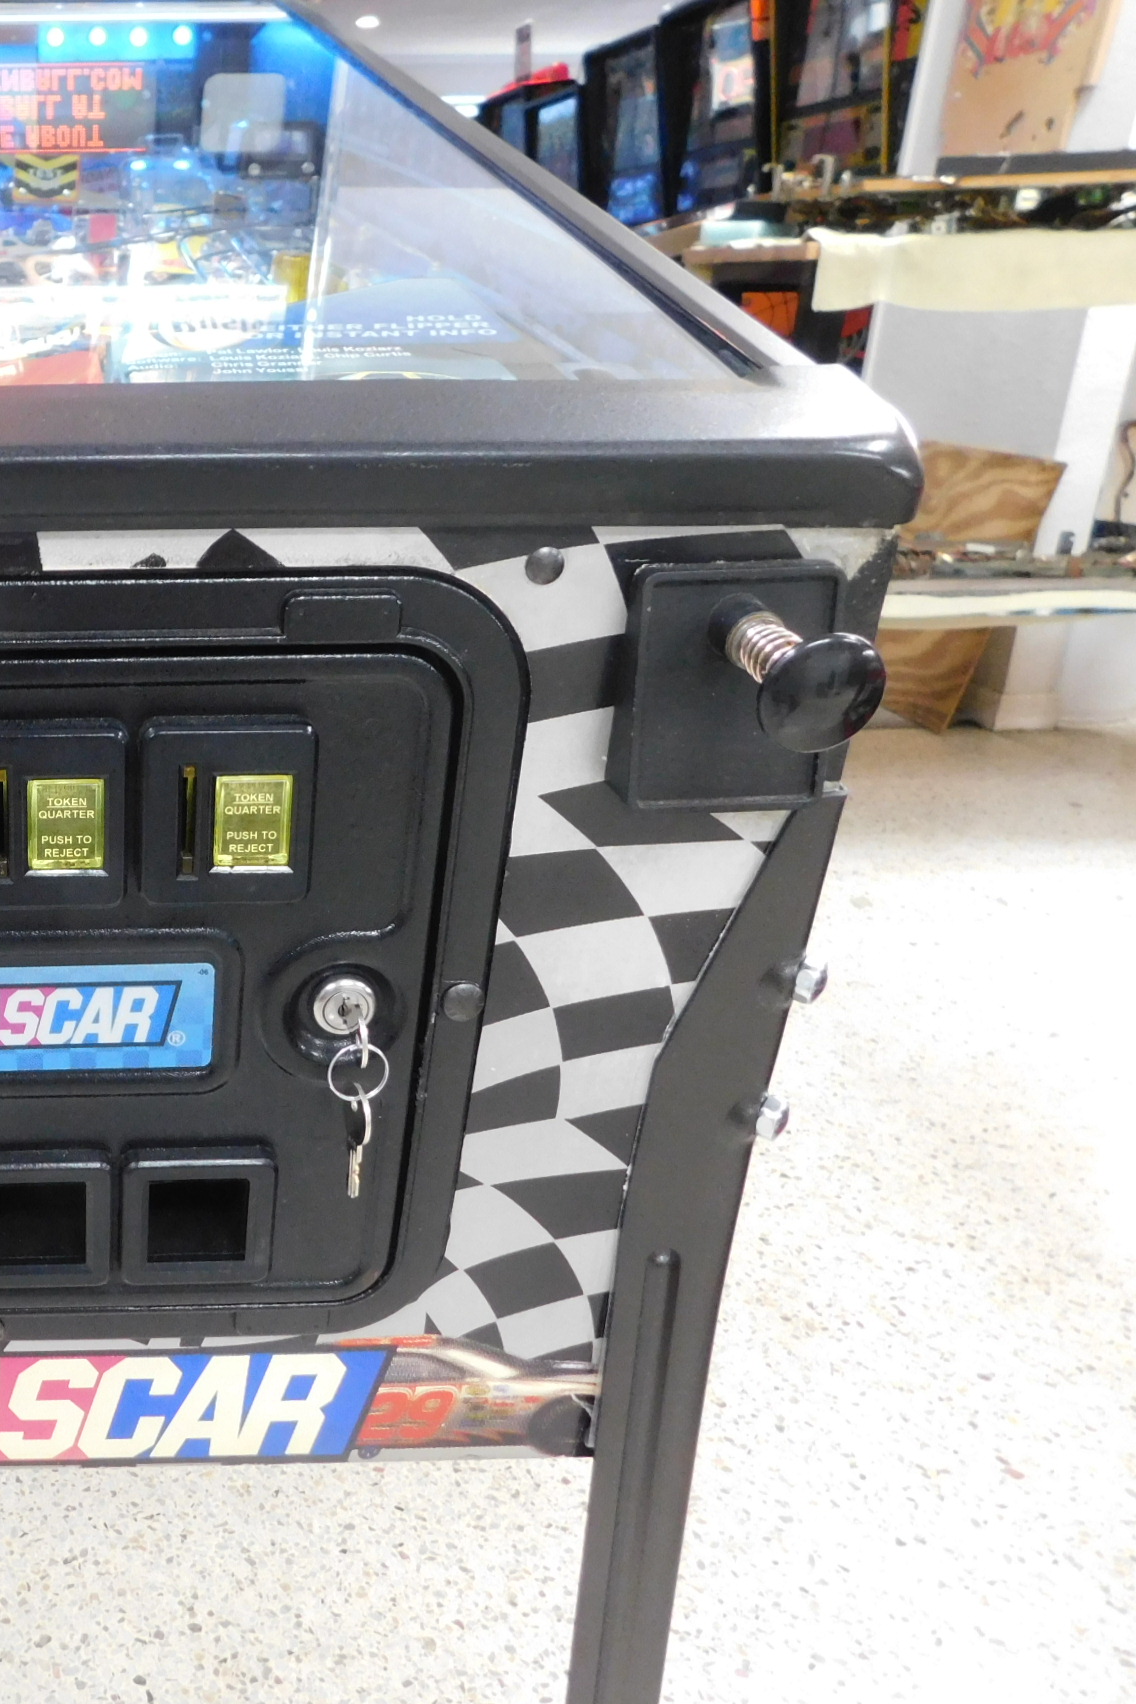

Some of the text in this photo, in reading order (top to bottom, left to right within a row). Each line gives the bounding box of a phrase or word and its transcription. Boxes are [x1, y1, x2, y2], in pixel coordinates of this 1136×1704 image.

[406, 314, 482, 322] HOLD
[374, 321, 490, 330] FLIPPER
[429, 328, 498, 337] INFO
[46, 797, 87, 807] TOKEN
[232, 792, 274, 803] TOKEN
[38, 809, 95, 819] QUARTER
[224, 804, 281, 815] QUARTER
[41, 834, 93, 845] PUSH TO
[226, 830, 278, 841] PUSH TO
[44, 847, 89, 858] REJECT
[228, 843, 274, 853] REJECT
